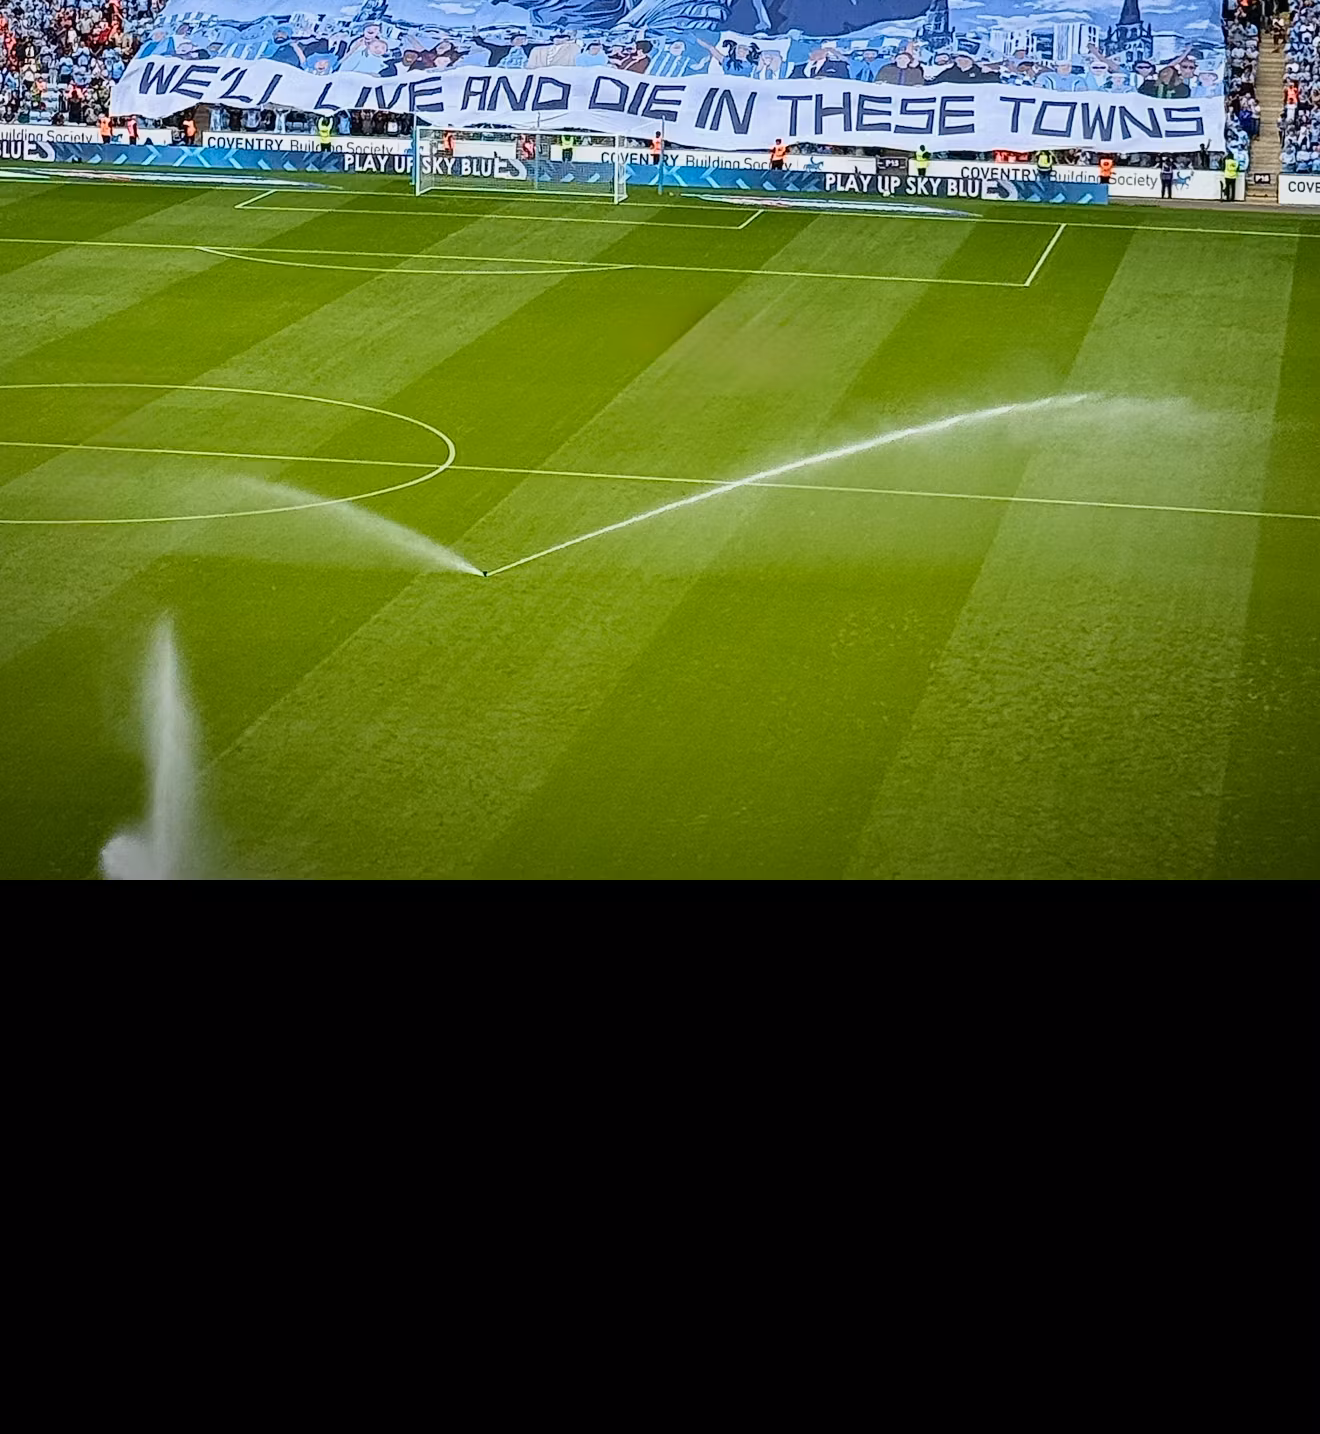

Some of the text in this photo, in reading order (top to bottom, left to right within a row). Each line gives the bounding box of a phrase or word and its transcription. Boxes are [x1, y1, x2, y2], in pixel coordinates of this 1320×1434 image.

[315, 76, 444, 113] LIVE
[461, 74, 571, 112] AND
[588, 76, 687, 122] DIE
[695, 87, 758, 135] IN
[777, 91, 976, 137] THESE
[1000, 95, 1205, 142] TOWNS
[46, 130, 93, 143] Society
[207, 136, 284, 150] COVENTRY
[346, 142, 393, 154] Society
[0, 140, 55, 163] LUES
[601, 152, 679, 166] COVENRY
[344, 154, 387, 173] PLAY
[422, 156, 456, 175] SKY
[825, 173, 872, 193] PLAY
[877, 175, 901, 196] UP
[905, 176, 941, 196] SKY
[961, 166, 1041, 181] COVENTRY
[1108, 171, 1158, 190] Society
